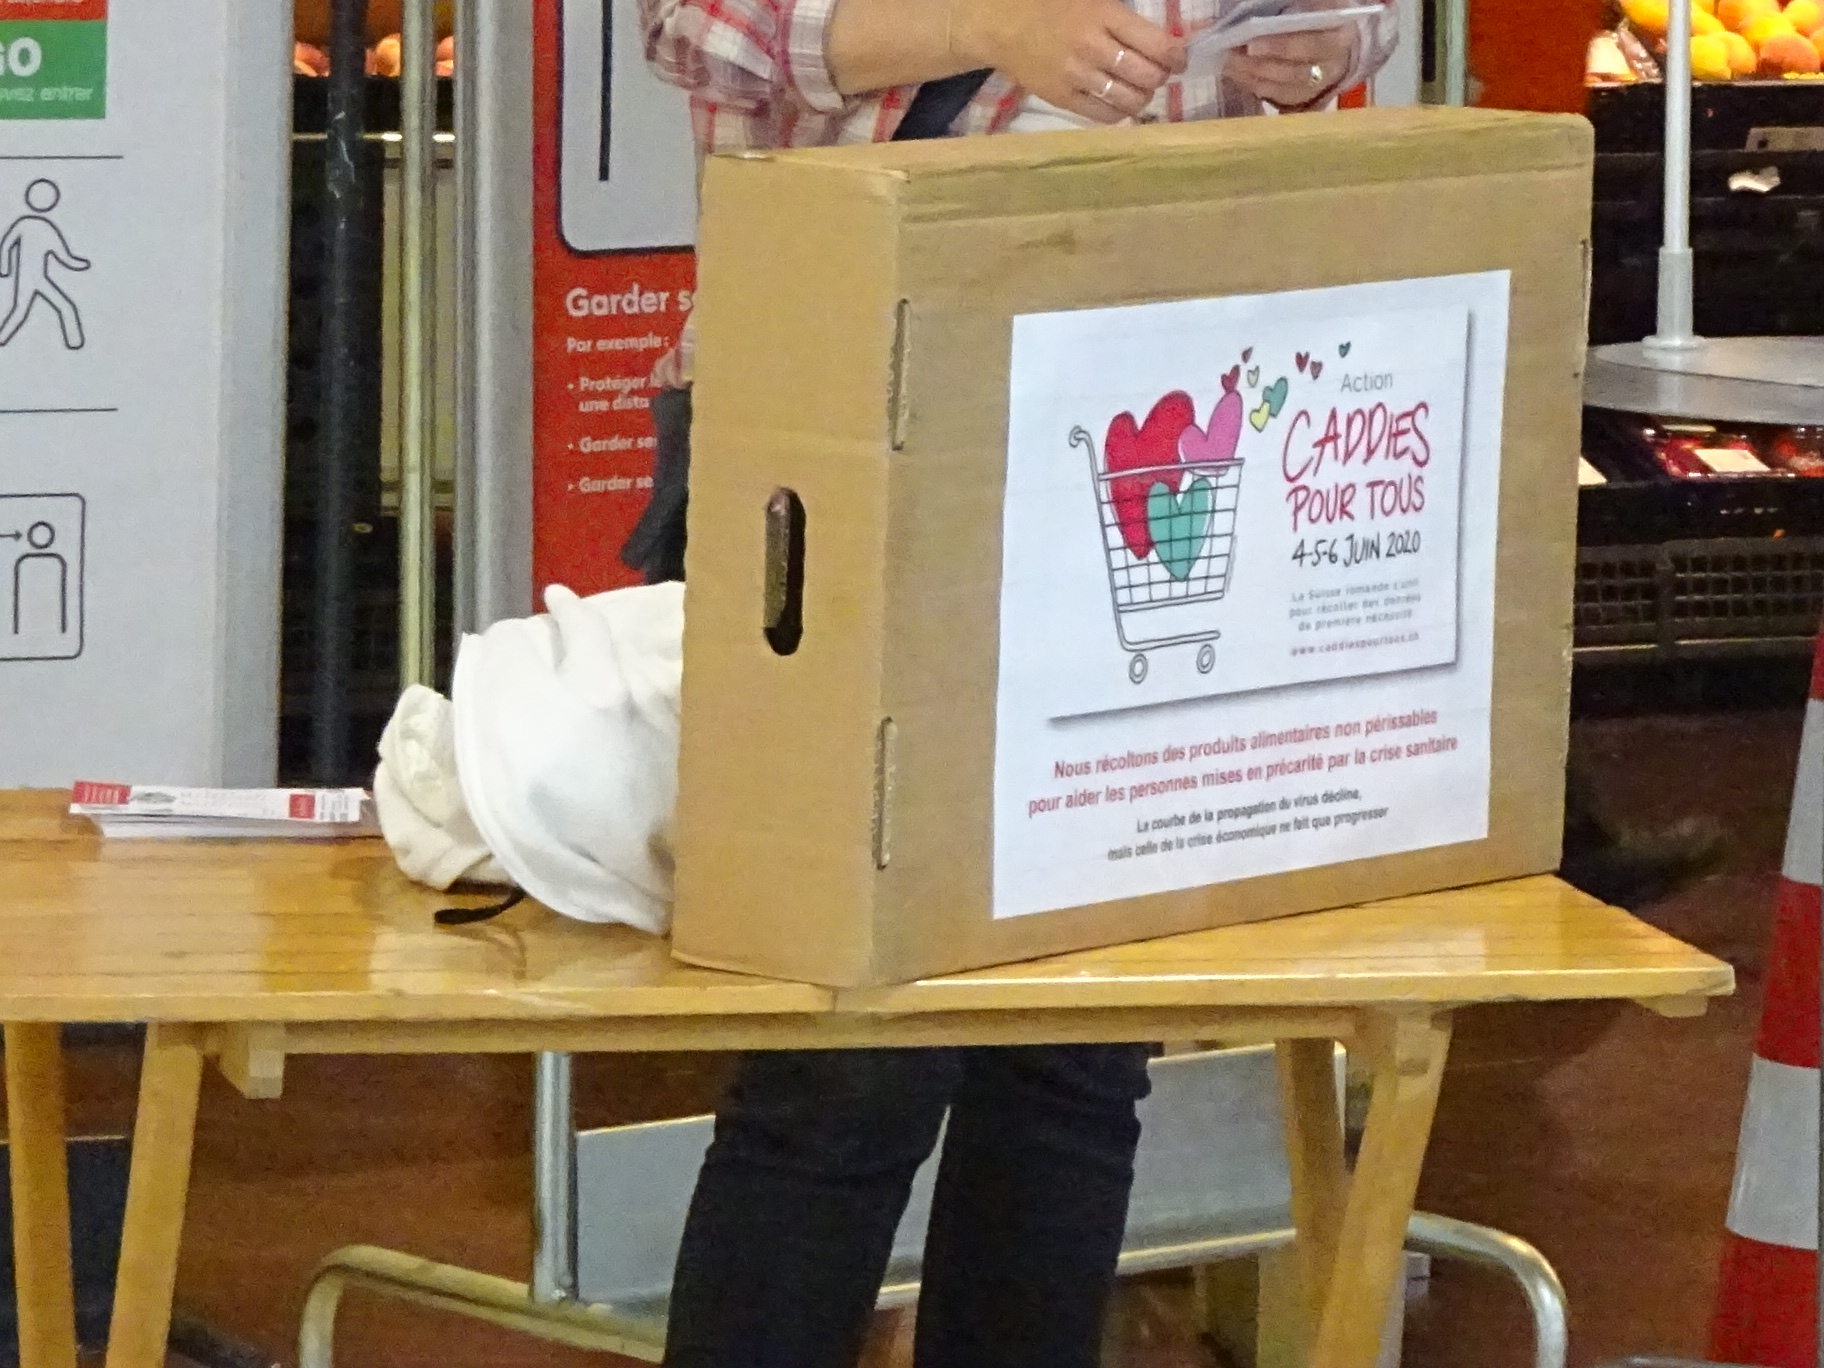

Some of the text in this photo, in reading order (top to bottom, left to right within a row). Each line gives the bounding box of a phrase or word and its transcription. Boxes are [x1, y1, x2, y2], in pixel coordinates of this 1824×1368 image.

[565, 282, 669, 317] Garder
[566, 336, 593, 352] Par
[1341, 372, 1393, 393] Action
[579, 435, 635, 454] Garder
[1283, 401, 1430, 482] CADDIES
[579, 477, 634, 493] Garder
[1286, 473, 1425, 532] POUR TOUS
[1343, 533, 1380, 567] JUIN
[1386, 530, 1421, 558] 2020
[1054, 708, 1438, 779] Nous récoltons des produits alimentaires non périssables
[1028, 735, 1458, 819] pour aider les personnes mises en précarité par la crise sanitaire
[1152, 813, 1186, 831] courbe
[1188, 811, 1202, 824] de
[1204, 808, 1214, 822] la
[1278, 796, 1292, 811] du
[1293, 792, 1319, 809] virus
[1107, 846, 1132, 861] mais
[1135, 840, 1158, 857] celle
[1160, 837, 1174, 853] de
[1175, 836, 1185, 851] la
[1311, 815, 1331, 832] que
[1333, 806, 1389, 829] progresser
